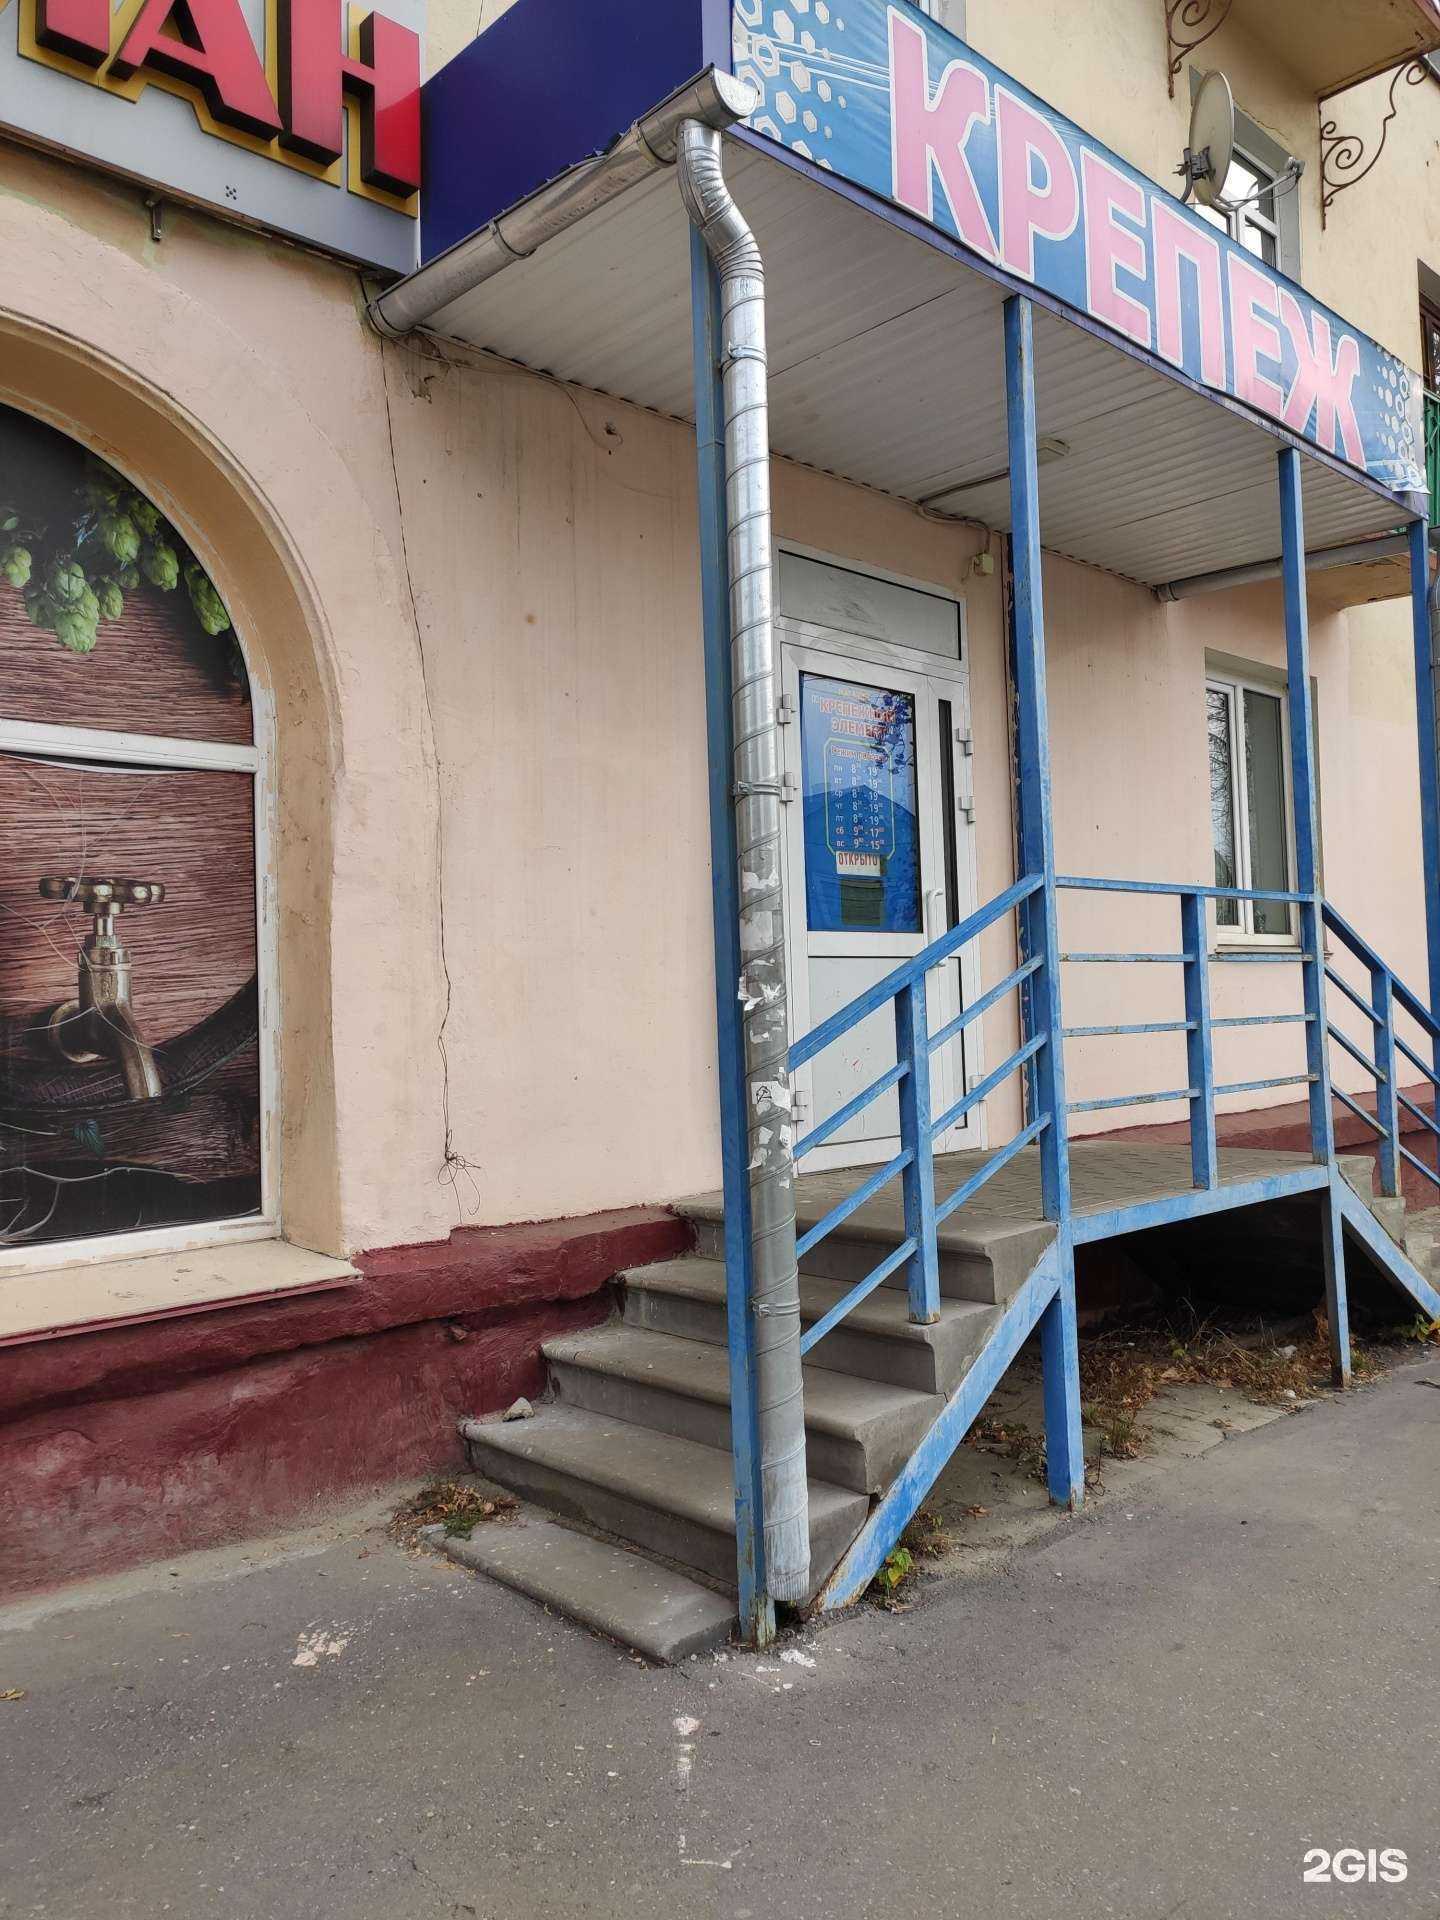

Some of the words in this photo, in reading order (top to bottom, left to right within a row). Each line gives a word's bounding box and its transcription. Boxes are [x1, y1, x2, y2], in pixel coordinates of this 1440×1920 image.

[35, 0, 422, 200] АН
[887, 5, 1367, 470] КРЕПЕЖ
[838, 852, 878, 866] ОТКРЫТО
